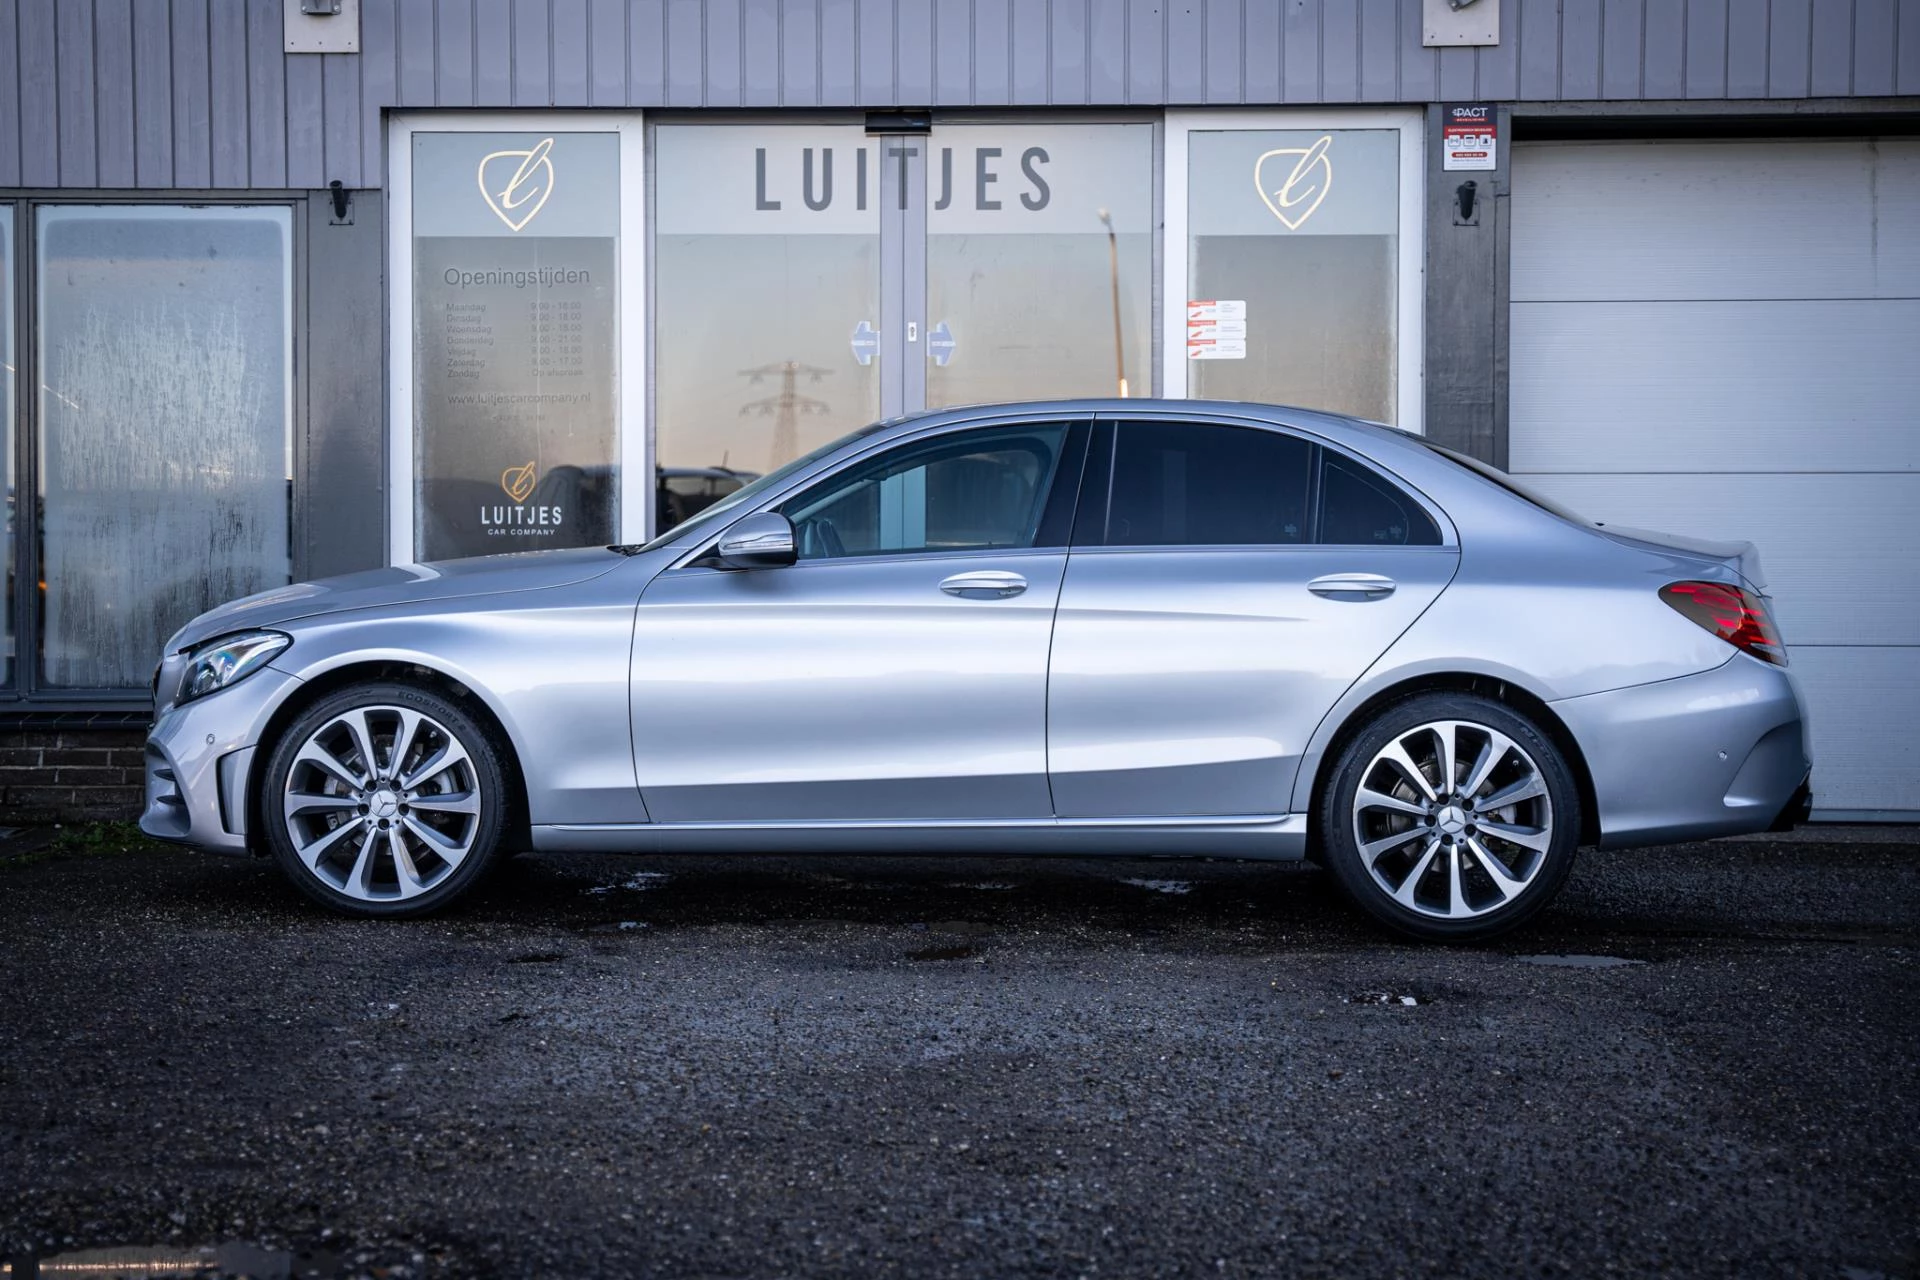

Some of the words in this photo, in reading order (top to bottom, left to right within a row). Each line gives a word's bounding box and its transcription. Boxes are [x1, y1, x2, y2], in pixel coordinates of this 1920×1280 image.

[1456, 107, 1488, 117] PACT
[755, 146, 1051, 211] LUITJES
[444, 267, 590, 289] Openingstijden
[531, 302, 550, 310] 900
[559, 335, 582, 343] 2100
[559, 357, 582, 365] 1700
[447, 370, 480, 379] Zondag
[447, 392, 591, 406] www.luitjescarcompany.nl
[481, 506, 562, 525] LUITJES
[487, 528, 506, 536] CAR
[510, 528, 556, 536] COMPANY
